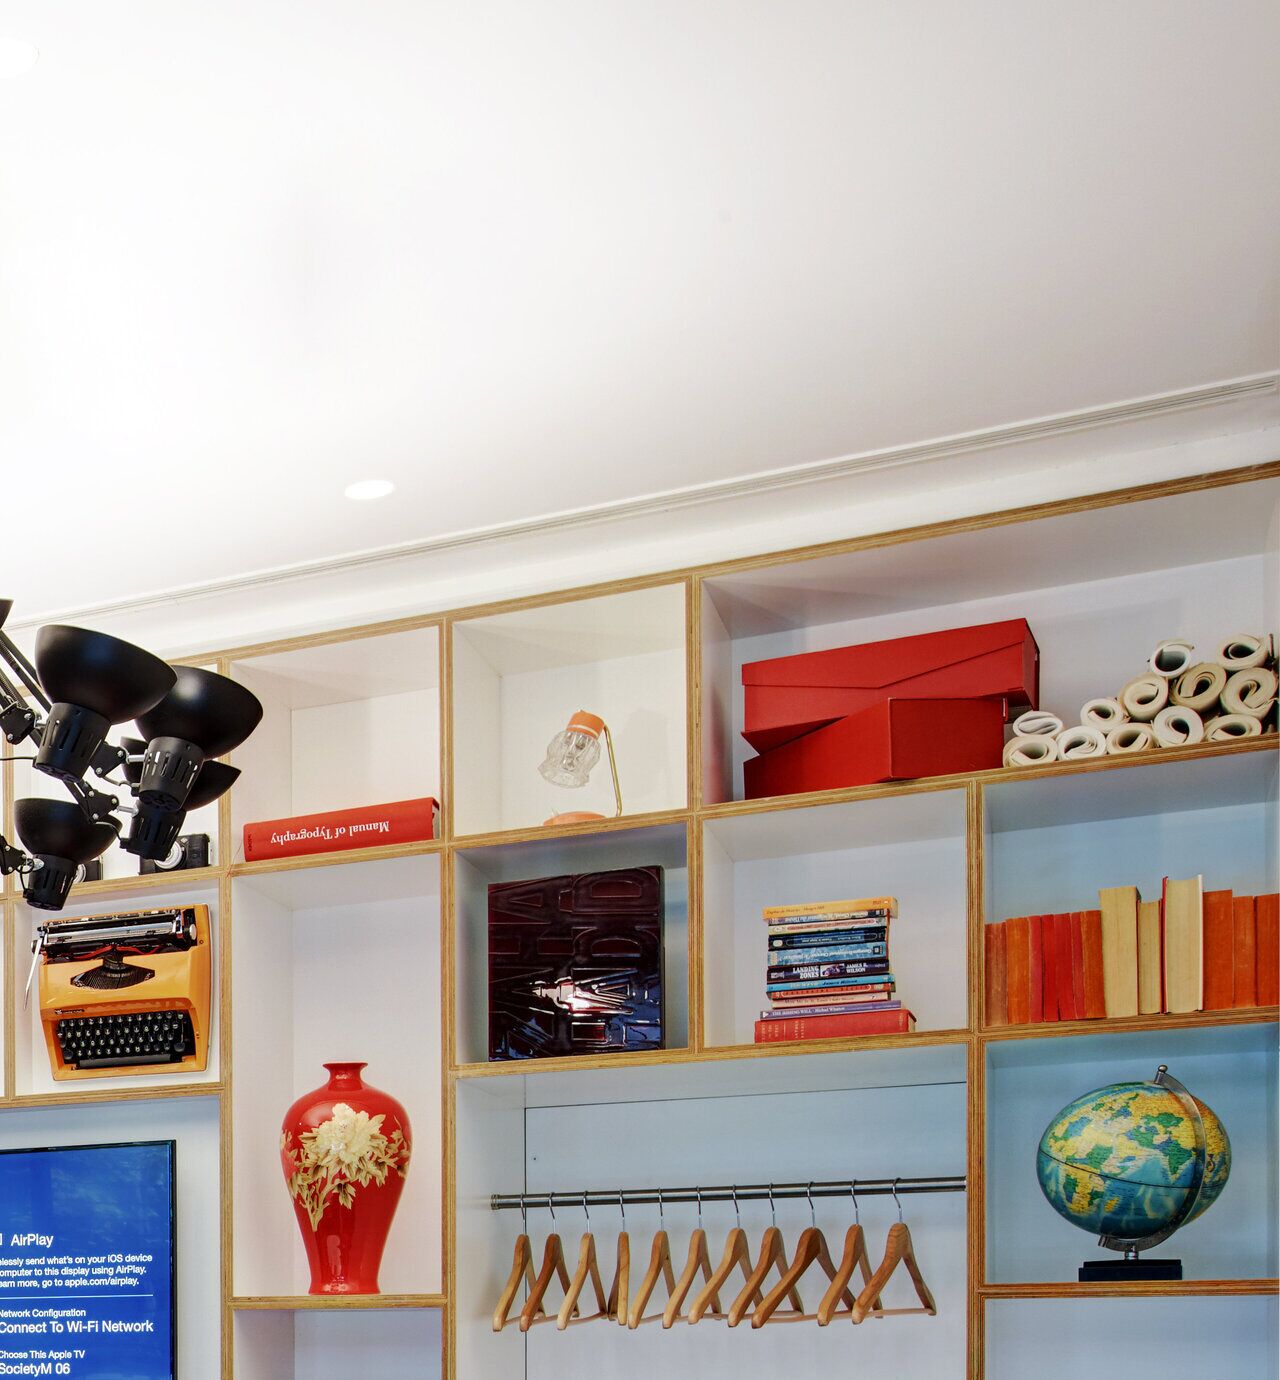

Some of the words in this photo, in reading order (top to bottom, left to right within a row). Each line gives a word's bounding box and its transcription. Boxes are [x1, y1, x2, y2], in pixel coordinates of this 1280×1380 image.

[334, 826, 346, 839] of
[350, 820, 390, 837] Manual
[271, 828, 333, 845] Typography
[800, 971, 820, 979] ZONES
[10, 1233, 54, 1248] AirPlay
[25, 1256, 45, 1265] send
[47, 1255, 73, 1265] what's
[87, 1256, 106, 1265] your
[107, 1254, 123, 1263] iOS
[125, 1253, 153, 1262] device
[34, 1268, 43, 1276] to
[44, 1267, 59, 1276] this
[60, 1267, 90, 1277] display
[91, 1266, 114, 1276] using
[116, 1265, 147, 1275] AirPlay.
[17, 1280, 40, 1288] more,
[42, 1280, 53, 1288] go
[54, 1279, 63, 1287] to
[64, 1277, 140, 1288] apple.com/airplay.
[32, 1308, 86, 1319] Configuration
[49, 1321, 64, 1333] To
[66, 1320, 98, 1333] Wi-Fi
[101, 1320, 154, 1333] Network
[29, 1350, 47, 1359] This
[48, 1350, 72, 1360] Apple
[73, 1350, 86, 1358] TV
[55, 1363, 71, 1375] 06
